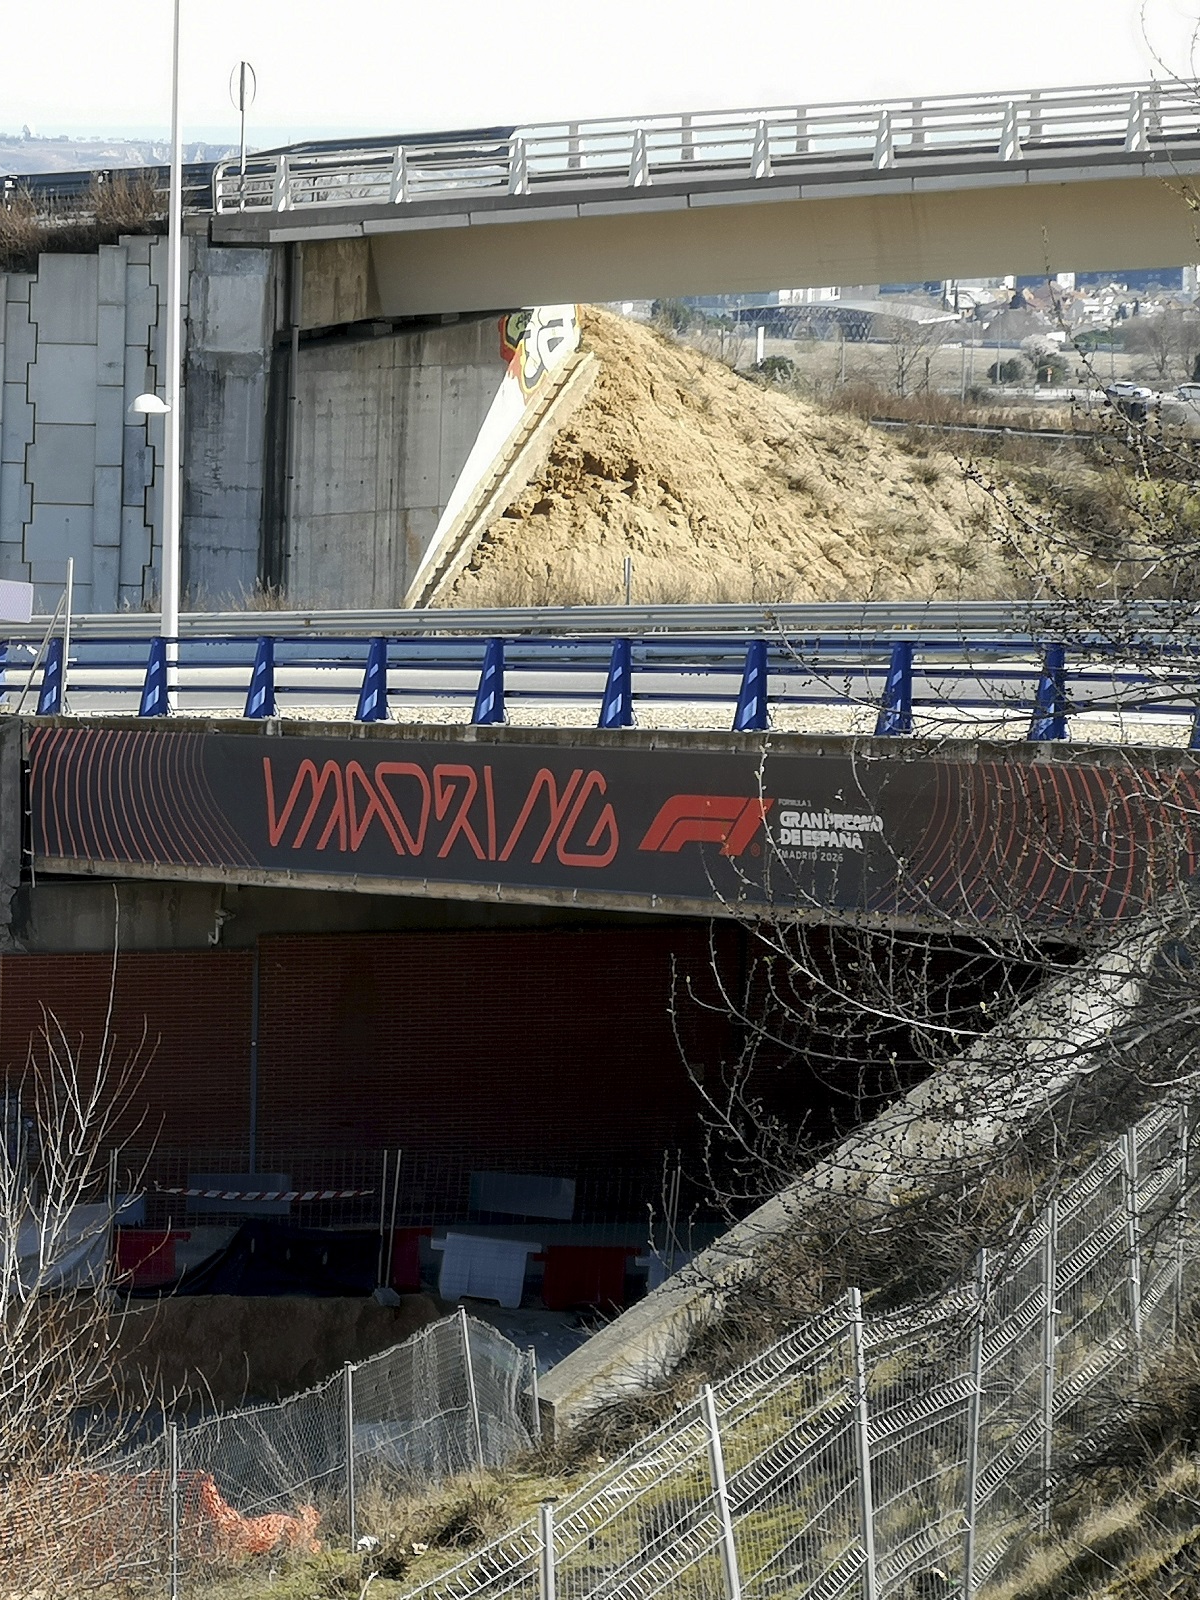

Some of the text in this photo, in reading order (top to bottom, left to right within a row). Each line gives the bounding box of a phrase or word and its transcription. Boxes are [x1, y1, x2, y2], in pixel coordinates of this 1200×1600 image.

[263, 755, 620, 868] MADRING
[780, 811, 823, 829] GRAN
[780, 829, 864, 849] DE ESPAÑA
[780, 849, 817, 861] MADRID
